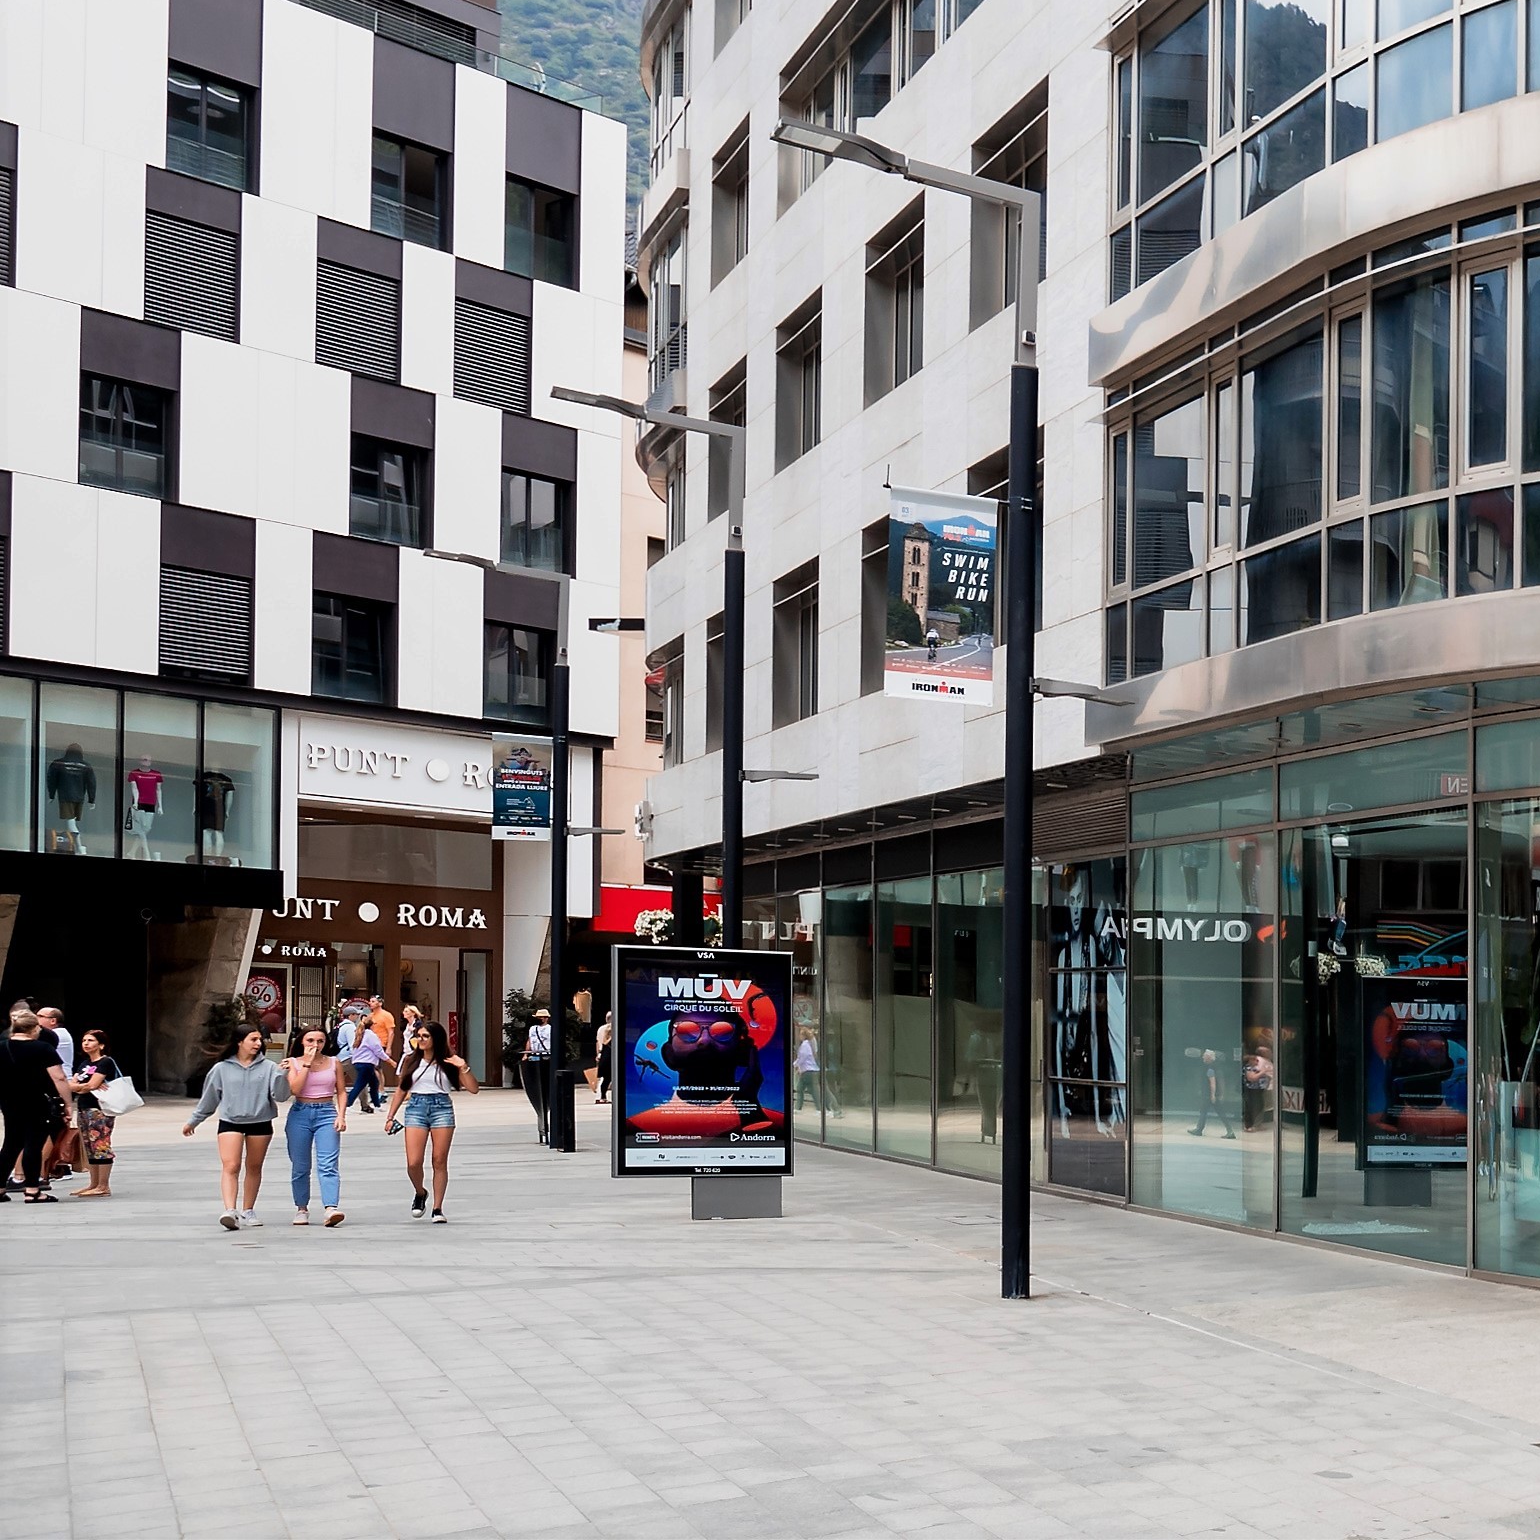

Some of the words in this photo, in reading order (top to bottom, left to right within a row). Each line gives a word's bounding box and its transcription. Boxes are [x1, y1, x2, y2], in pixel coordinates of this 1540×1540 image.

[942, 552, 990, 571] SWIM
[947, 569, 989, 587] BIKE
[955, 586, 989, 602] RUN
[912, 681, 965, 695] IRONMAN
[307, 743, 410, 778] PUNT
[397, 903, 488, 929] ROMA
[281, 945, 327, 958] ROMA
[697, 951, 715, 959] VSA
[663, 1003, 698, 1014] CIRQUE
[699, 1004, 712, 1012] DU
[713, 1005, 744, 1013] SOLEIL
[740, 1133, 776, 1141] Andorra
